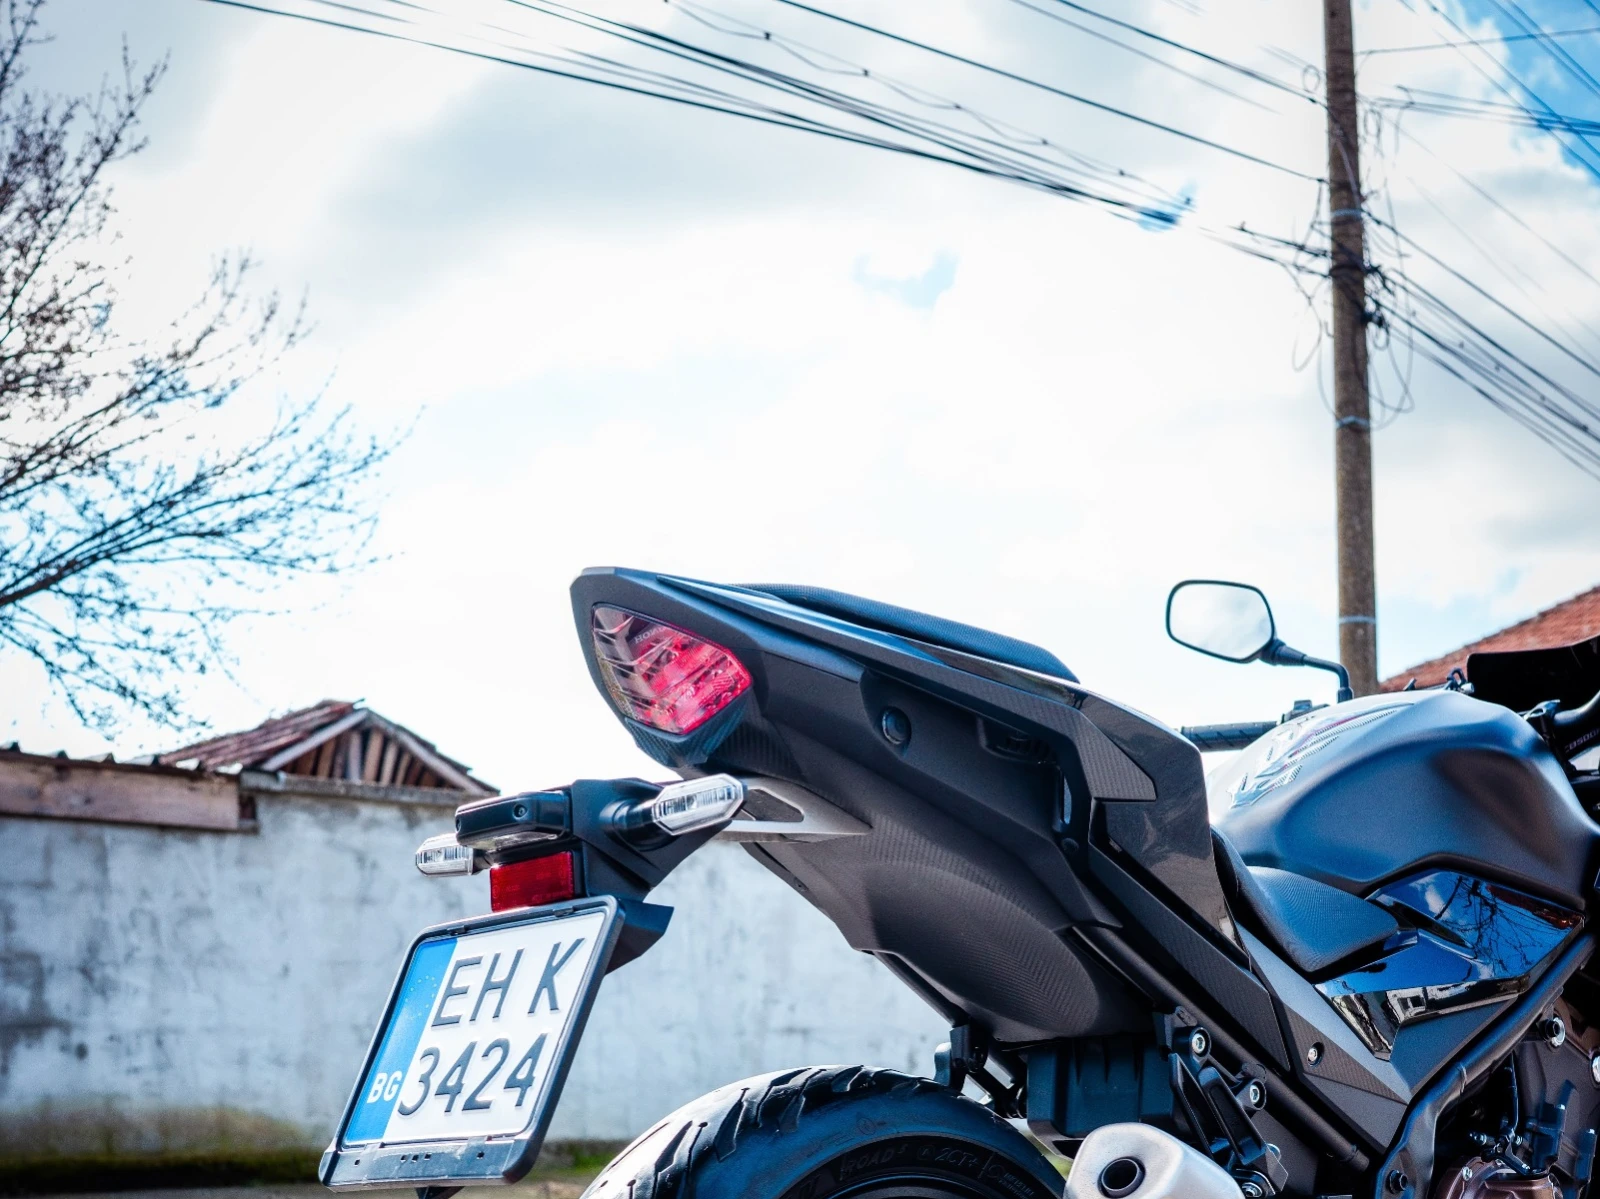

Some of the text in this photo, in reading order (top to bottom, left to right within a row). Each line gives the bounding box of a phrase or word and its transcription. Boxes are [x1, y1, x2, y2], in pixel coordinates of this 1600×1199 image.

[431, 937, 586, 1027] EH K
[366, 1070, 402, 1104] BG
[397, 1032, 548, 1116] 3424
